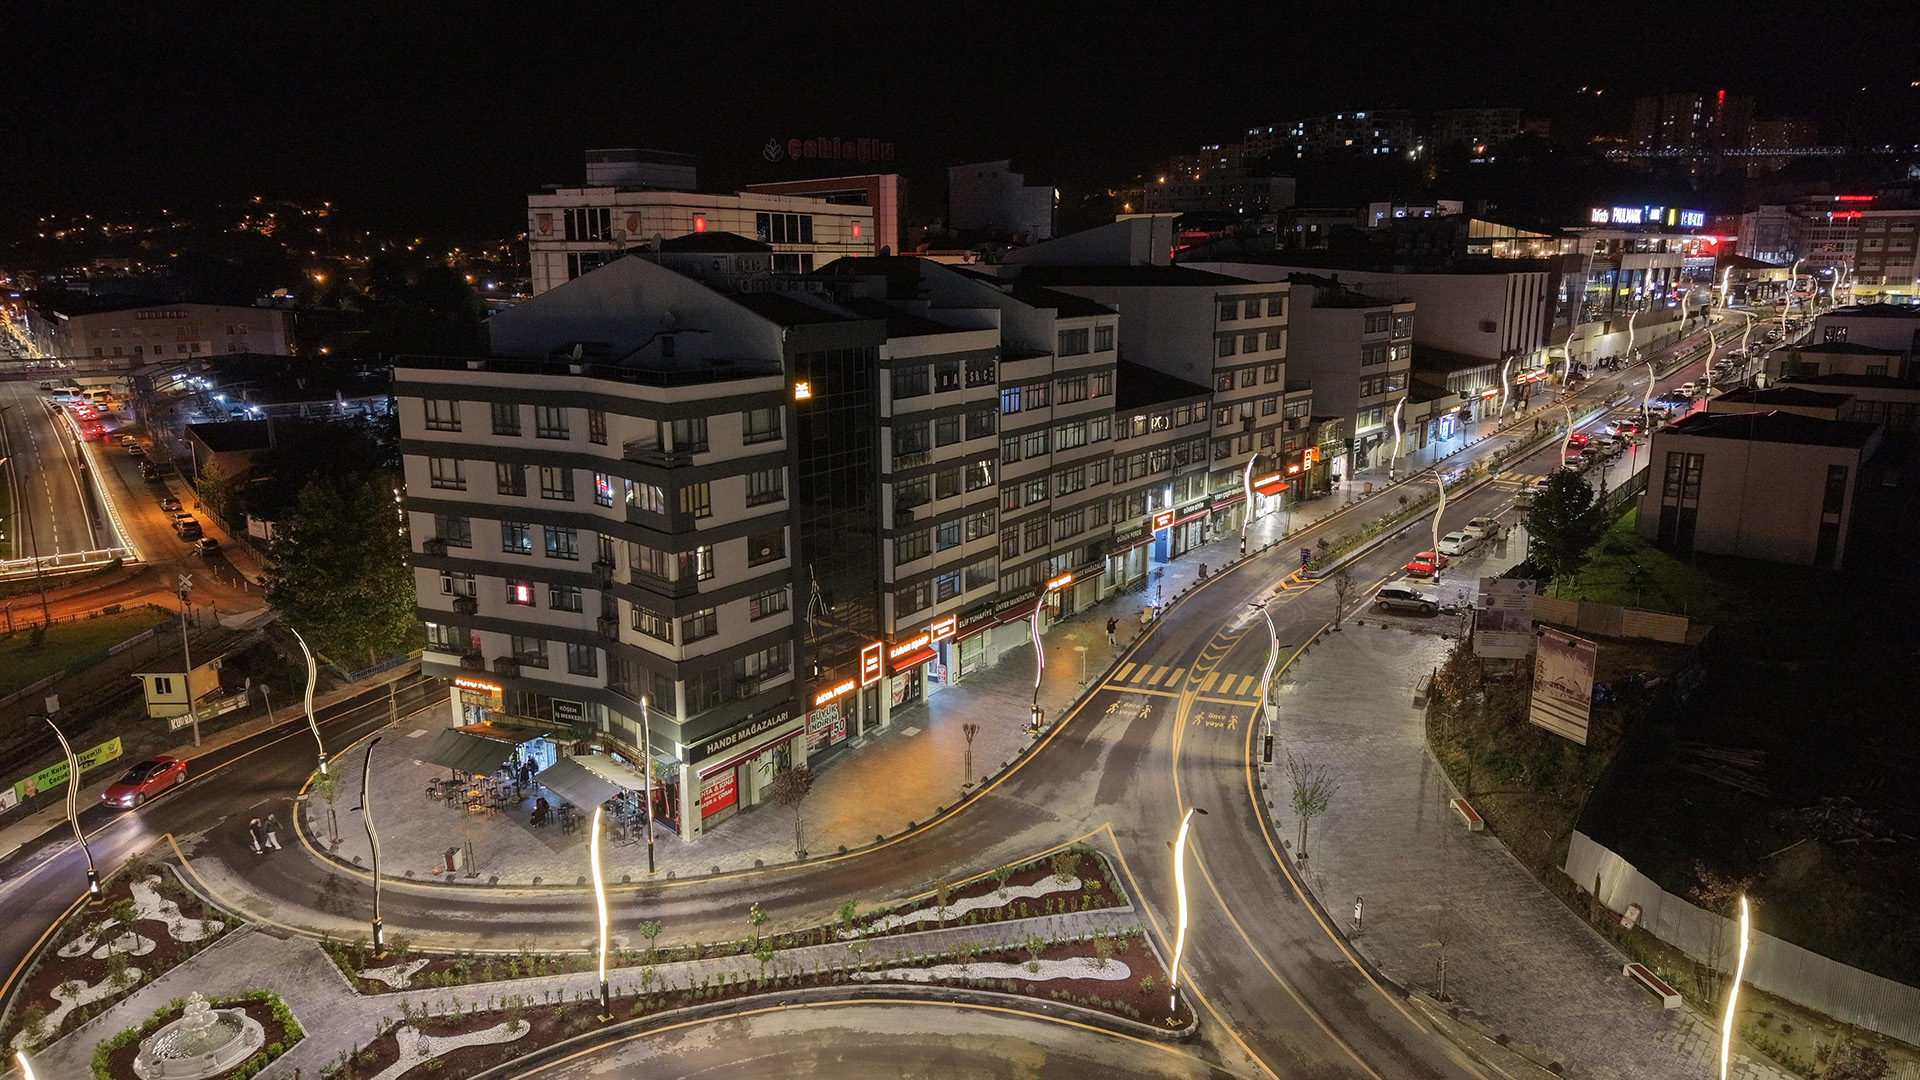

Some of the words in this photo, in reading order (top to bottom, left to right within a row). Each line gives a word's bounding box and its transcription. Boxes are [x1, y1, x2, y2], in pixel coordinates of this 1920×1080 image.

[558, 705, 577, 714] KÖŞEM
[810, 704, 837, 724] BÜYÜK
[1208, 712, 1227, 720] önce
[809, 713, 838, 733] İNDİRİM
[1205, 720, 1224, 728] yaya
[707, 734, 737, 755] HANDE
[737, 711, 789, 741] MAĞAZALARI
